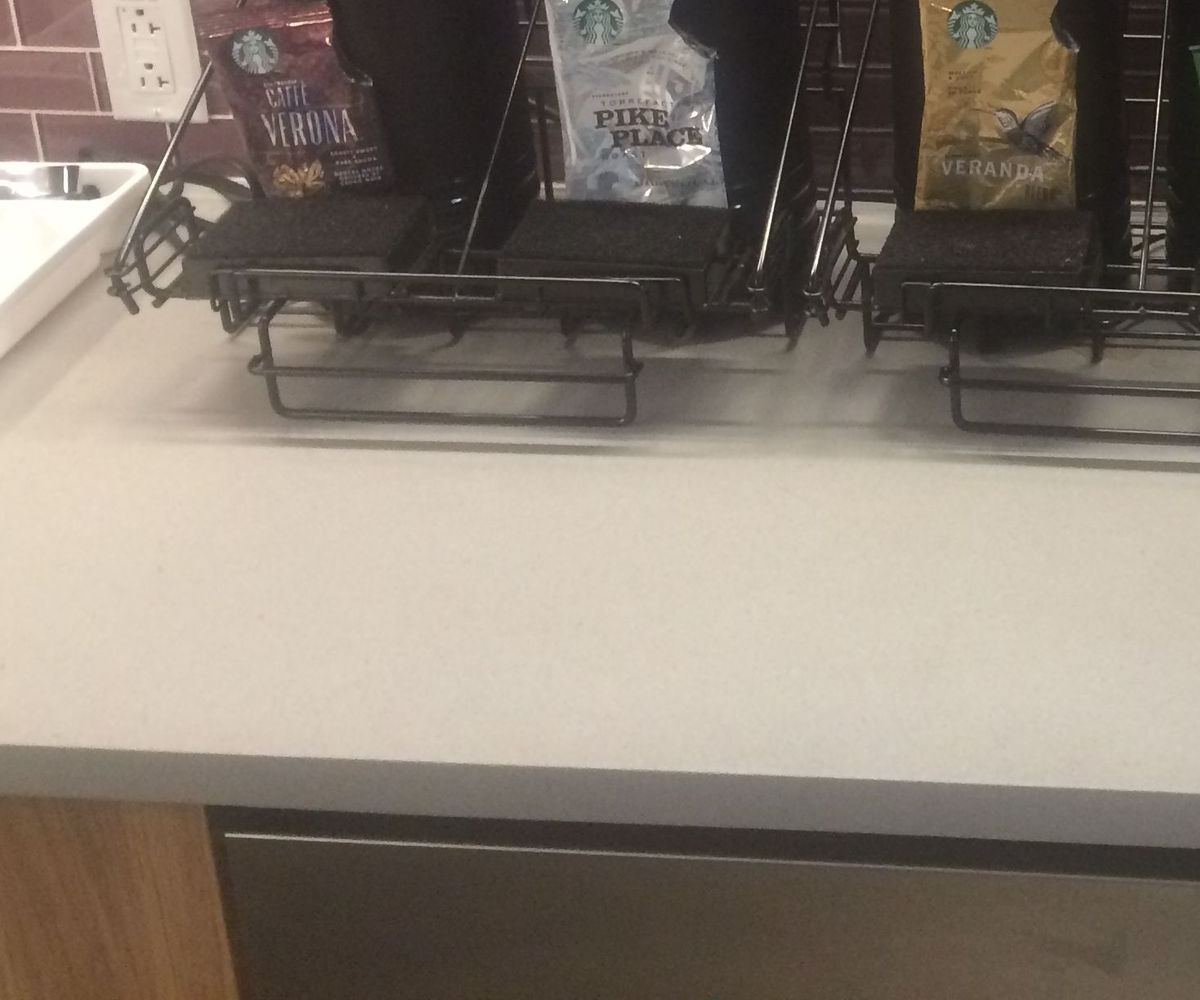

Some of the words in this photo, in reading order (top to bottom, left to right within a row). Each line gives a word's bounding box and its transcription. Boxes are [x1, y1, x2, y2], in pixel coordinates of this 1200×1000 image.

[260, 109, 359, 147] VERONA
[593, 107, 670, 129] PIKE
[611, 127, 704, 148] PLACE
[941, 159, 1046, 183] VERANDA
